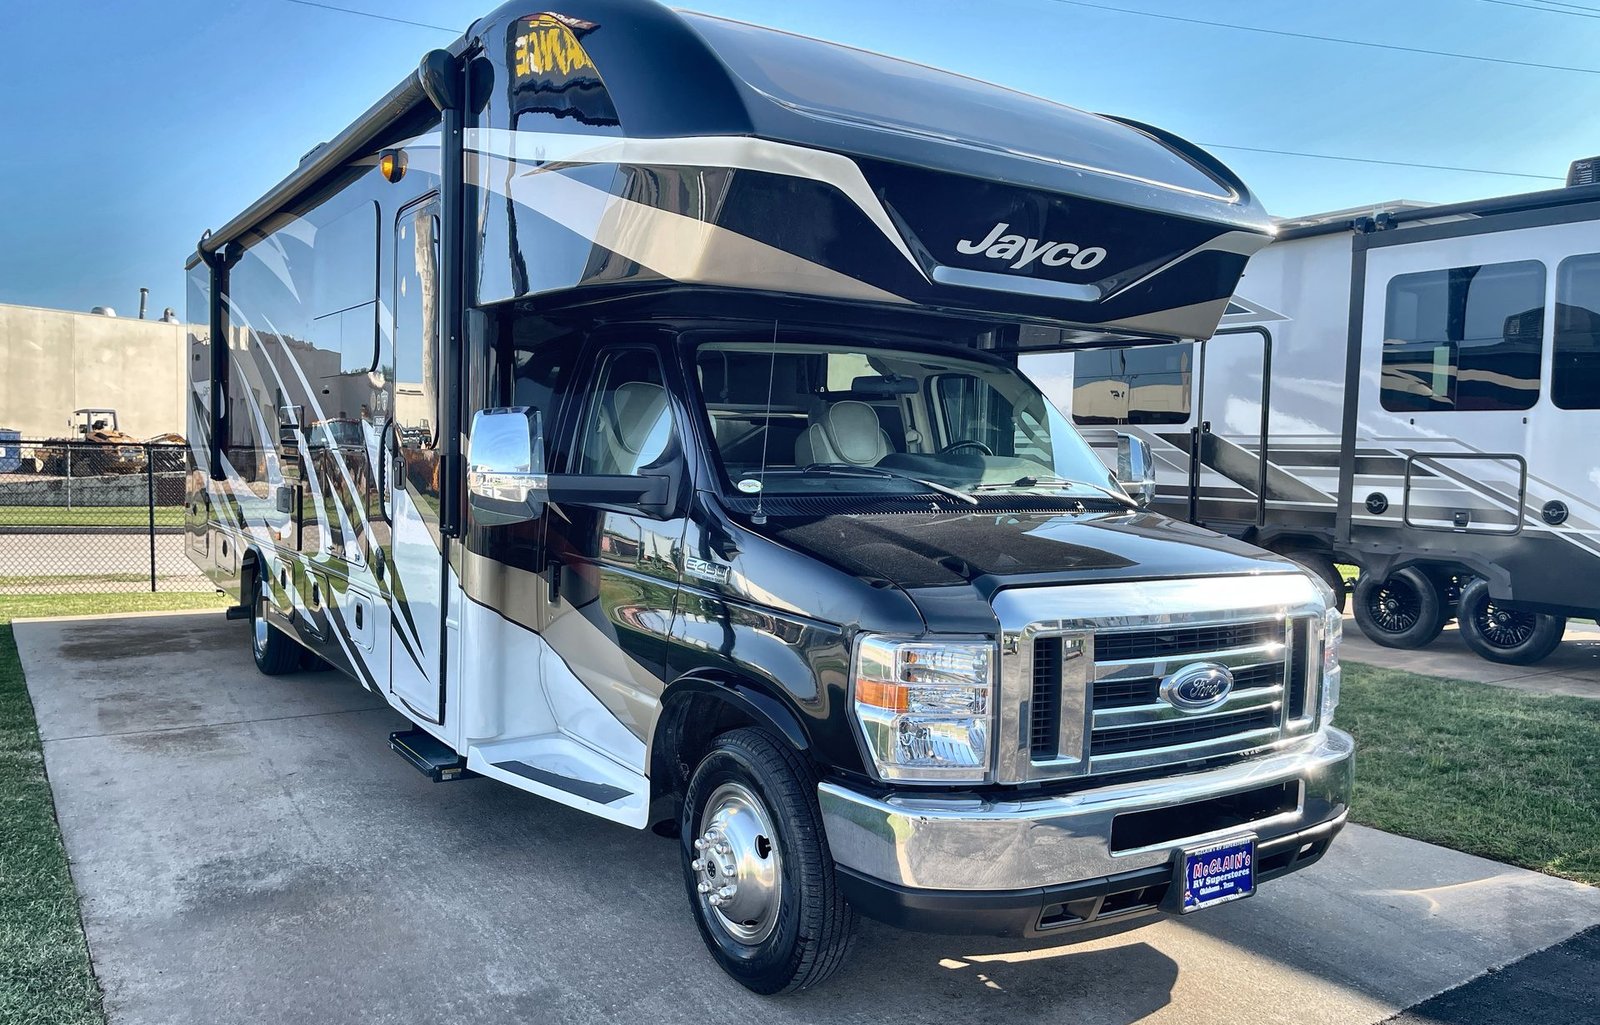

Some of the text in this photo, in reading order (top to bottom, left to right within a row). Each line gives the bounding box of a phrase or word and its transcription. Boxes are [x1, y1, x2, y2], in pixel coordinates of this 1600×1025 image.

[956, 222, 1107, 270] Jayco
[1190, 677, 1220, 697] Ford
[1193, 868, 1249, 889] RV Superstores
